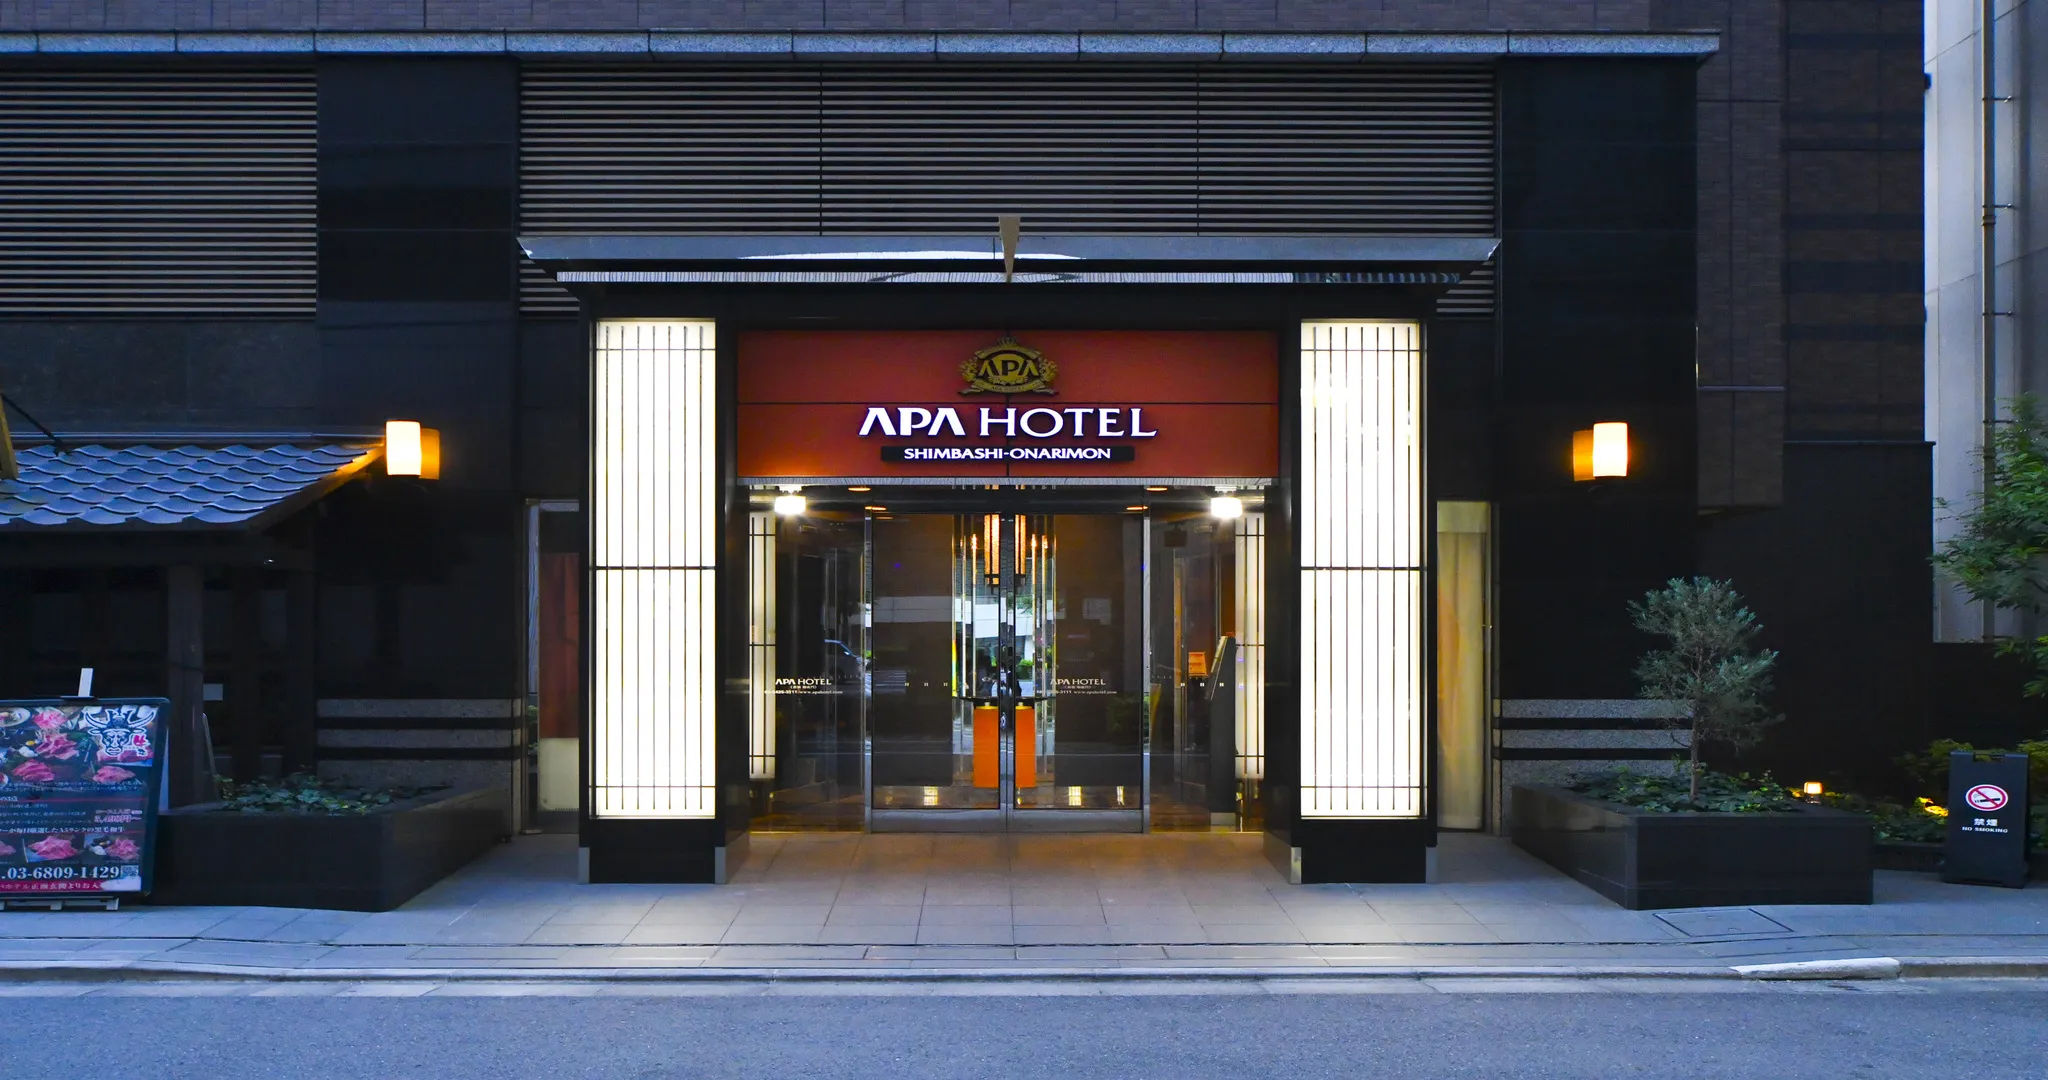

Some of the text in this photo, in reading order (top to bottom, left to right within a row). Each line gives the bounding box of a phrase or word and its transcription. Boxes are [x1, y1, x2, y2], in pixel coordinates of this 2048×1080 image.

[978, 359, 1040, 377] APA
[858, 406, 1158, 438] APA HOTEL
[903, 447, 1112, 460] SHIMBASHI-ONARIMON
[797, 678, 832, 686] HOTEL
[1072, 678, 1107, 686] HOTEL
[1973, 818, 1998, 827] 禁煙
